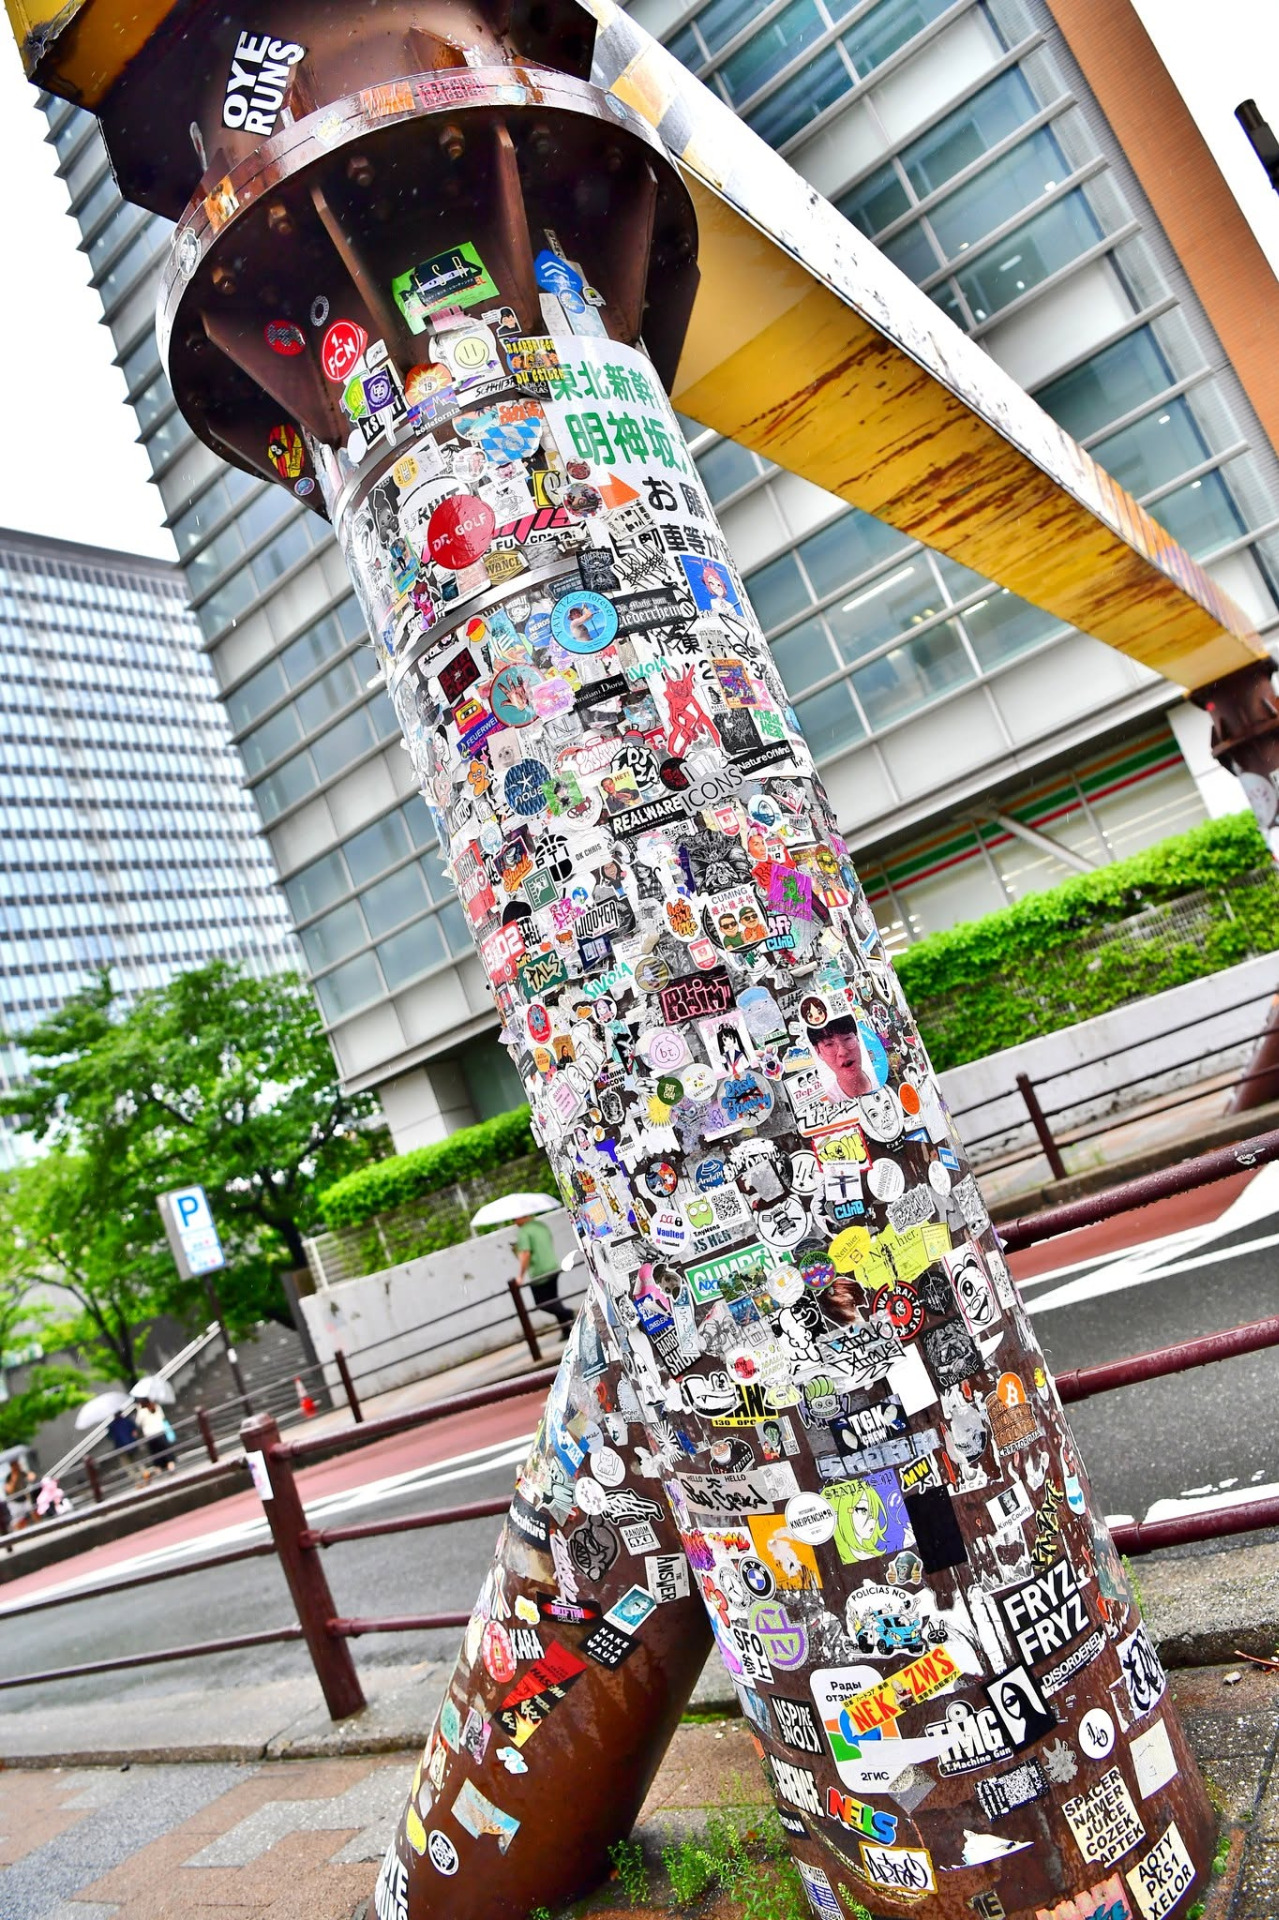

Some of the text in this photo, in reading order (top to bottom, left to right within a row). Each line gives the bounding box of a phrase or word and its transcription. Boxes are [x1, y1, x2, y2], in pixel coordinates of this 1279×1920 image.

[223, 31, 270, 129] OYE
[244, 40, 306, 136] RUNS
[327, 342, 359, 378] FCN
[551, 361, 662, 408] 東北新幹
[432, 513, 488, 552] DR. GOLF
[588, 591, 615, 618] forever
[619, 604, 682, 628] iederrhein
[684, 769, 743, 810] ICONS
[613, 797, 682, 835] REALWARE
[666, 898, 686, 917] hot
[711, 886, 749, 906] CUMING
[669, 908, 693, 930] girl
[524, 954, 562, 991] PALS
[177, 1196, 199, 1227] P
[656, 1226, 686, 1241] Vaulted
[894, 1228, 920, 1247] hier.
[656, 1329, 678, 1356] BARBE
[850, 1404, 887, 1434] TGK
[861, 1429, 888, 1448] CREW
[687, 1473, 747, 1483] HELLO HELLO
[1011, 1505, 1032, 1522] County
[624, 1526, 649, 1538] RANDOM
[656, 1556, 679, 1603] ANSWER
[852, 1586, 907, 1602] POLICIAS NO
[1003, 1566, 1077, 1631] FRYZ
[593, 1634, 623, 1656] NULA
[599, 1626, 630, 1650] NAKE
[733, 1627, 764, 1657] SFO
[1016, 1592, 1090, 1666] FRYZ
[904, 1647, 956, 1697] ZWS
[1041, 1631, 1102, 1686] DISORDERED
[831, 1681, 863, 1692] Рады
[843, 1698, 854, 1708] 日本
[848, 1691, 899, 1734] NEK
[944, 1748, 1012, 1772] T.Machine Gun
[860, 1771, 890, 1783] 2ГИС
[1064, 1769, 1120, 1817] SPACER
[1073, 1785, 1125, 1829] NAMER
[1085, 1801, 1127, 1840] JUICE
[1086, 1815, 1135, 1857] COZEK
[1098, 1827, 1145, 1867] APTEK
[1138, 1833, 1174, 1883] AQTY
[1147, 1853, 1181, 1898] PKS1
[1148, 1864, 1192, 1920] XELOR
